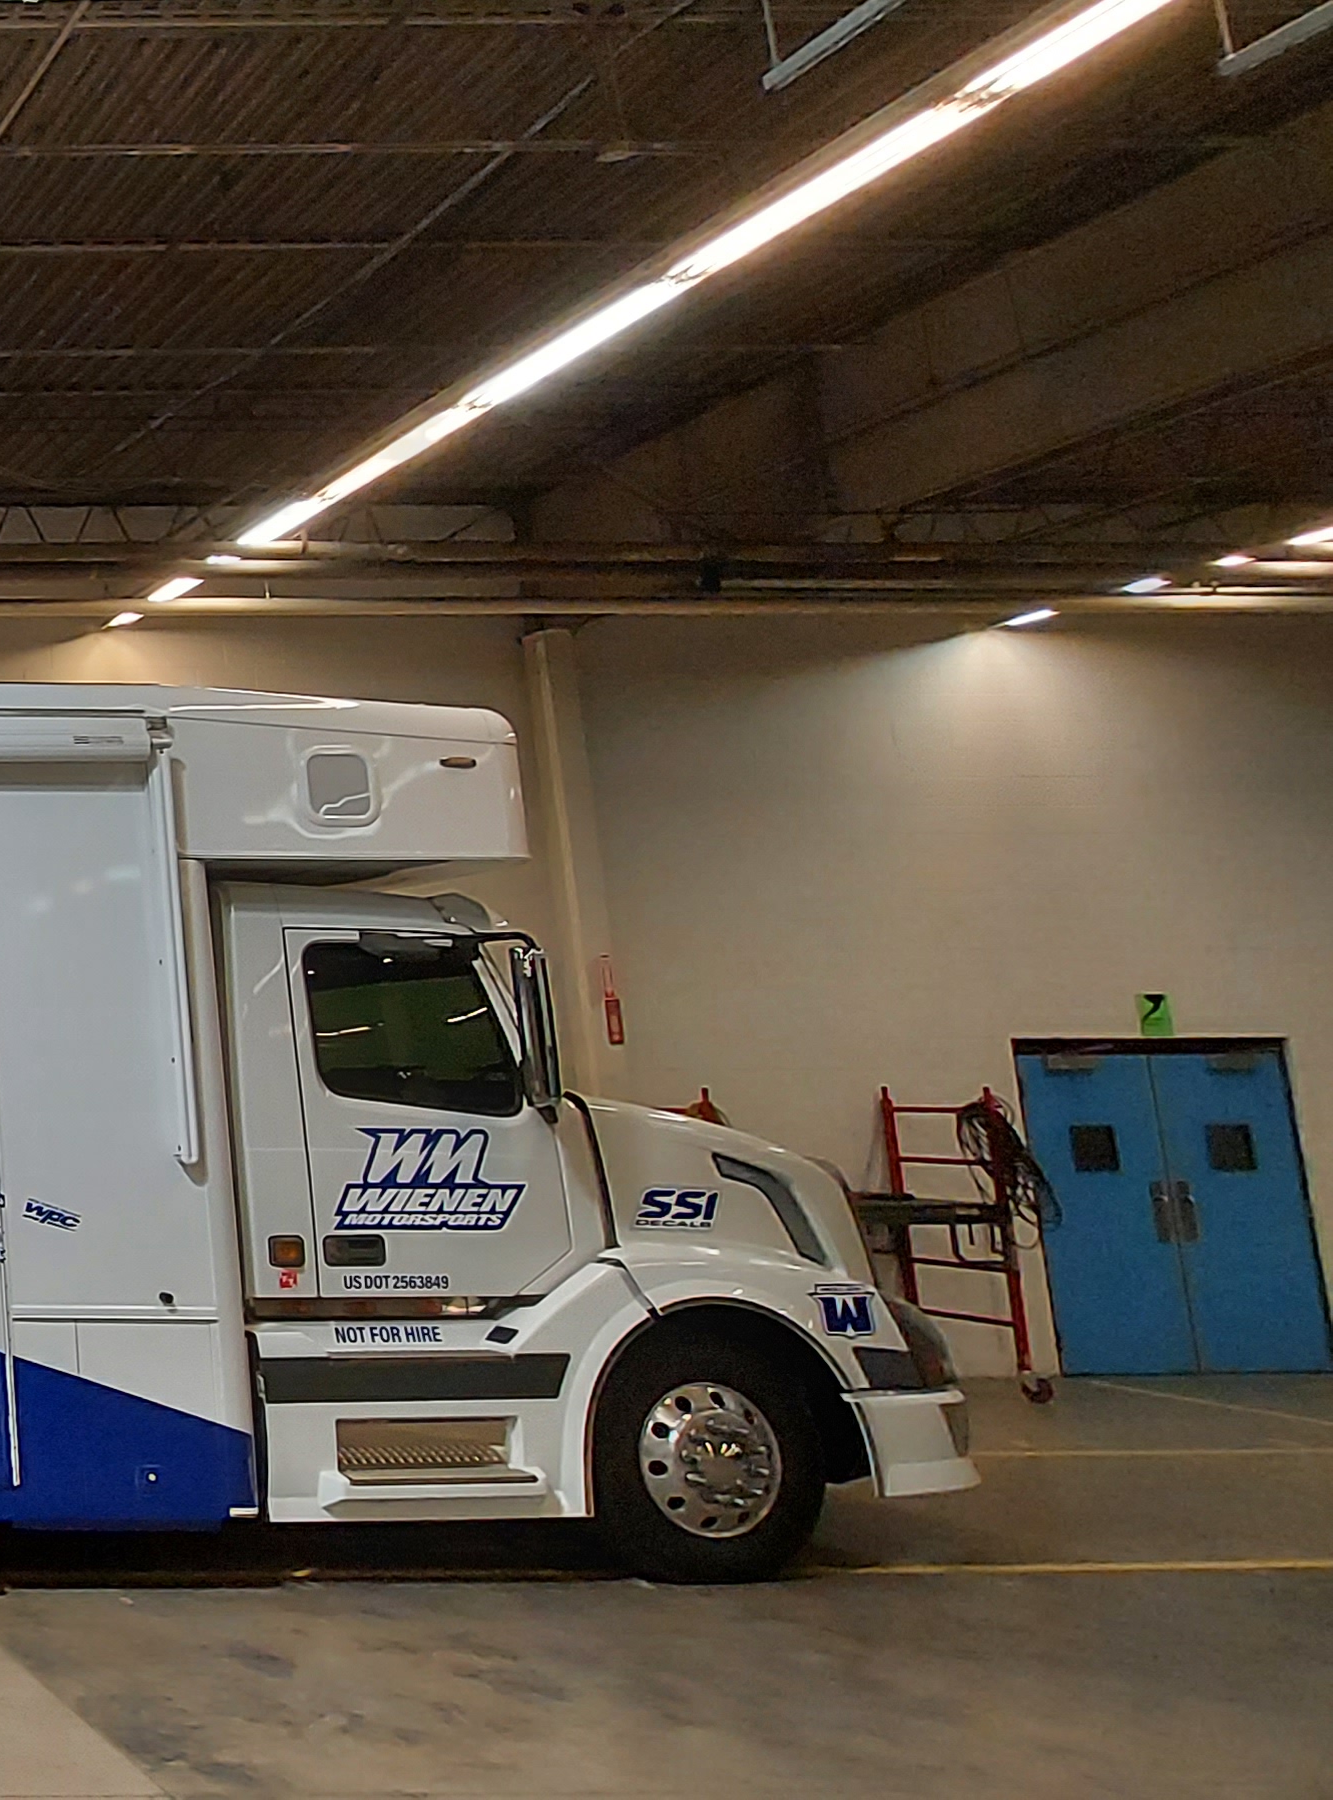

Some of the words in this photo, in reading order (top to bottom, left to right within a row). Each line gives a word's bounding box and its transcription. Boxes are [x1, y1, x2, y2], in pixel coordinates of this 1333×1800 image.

[368, 1133, 485, 1183] WM
[342, 1188, 518, 1212] WIENEN
[639, 1189, 719, 1221] SSI
[343, 1212, 505, 1227] MOTORSPORTS
[635, 1219, 712, 1228] DECALS
[343, 1275, 362, 1290] US
[364, 1275, 391, 1290] DOT
[392, 1275, 450, 1290] 2563849
[818, 1296, 871, 1333] W
[334, 1326, 366, 1344] NOT
[370, 1326, 400, 1343] FOR
[404, 1326, 443, 1343] HIRE
